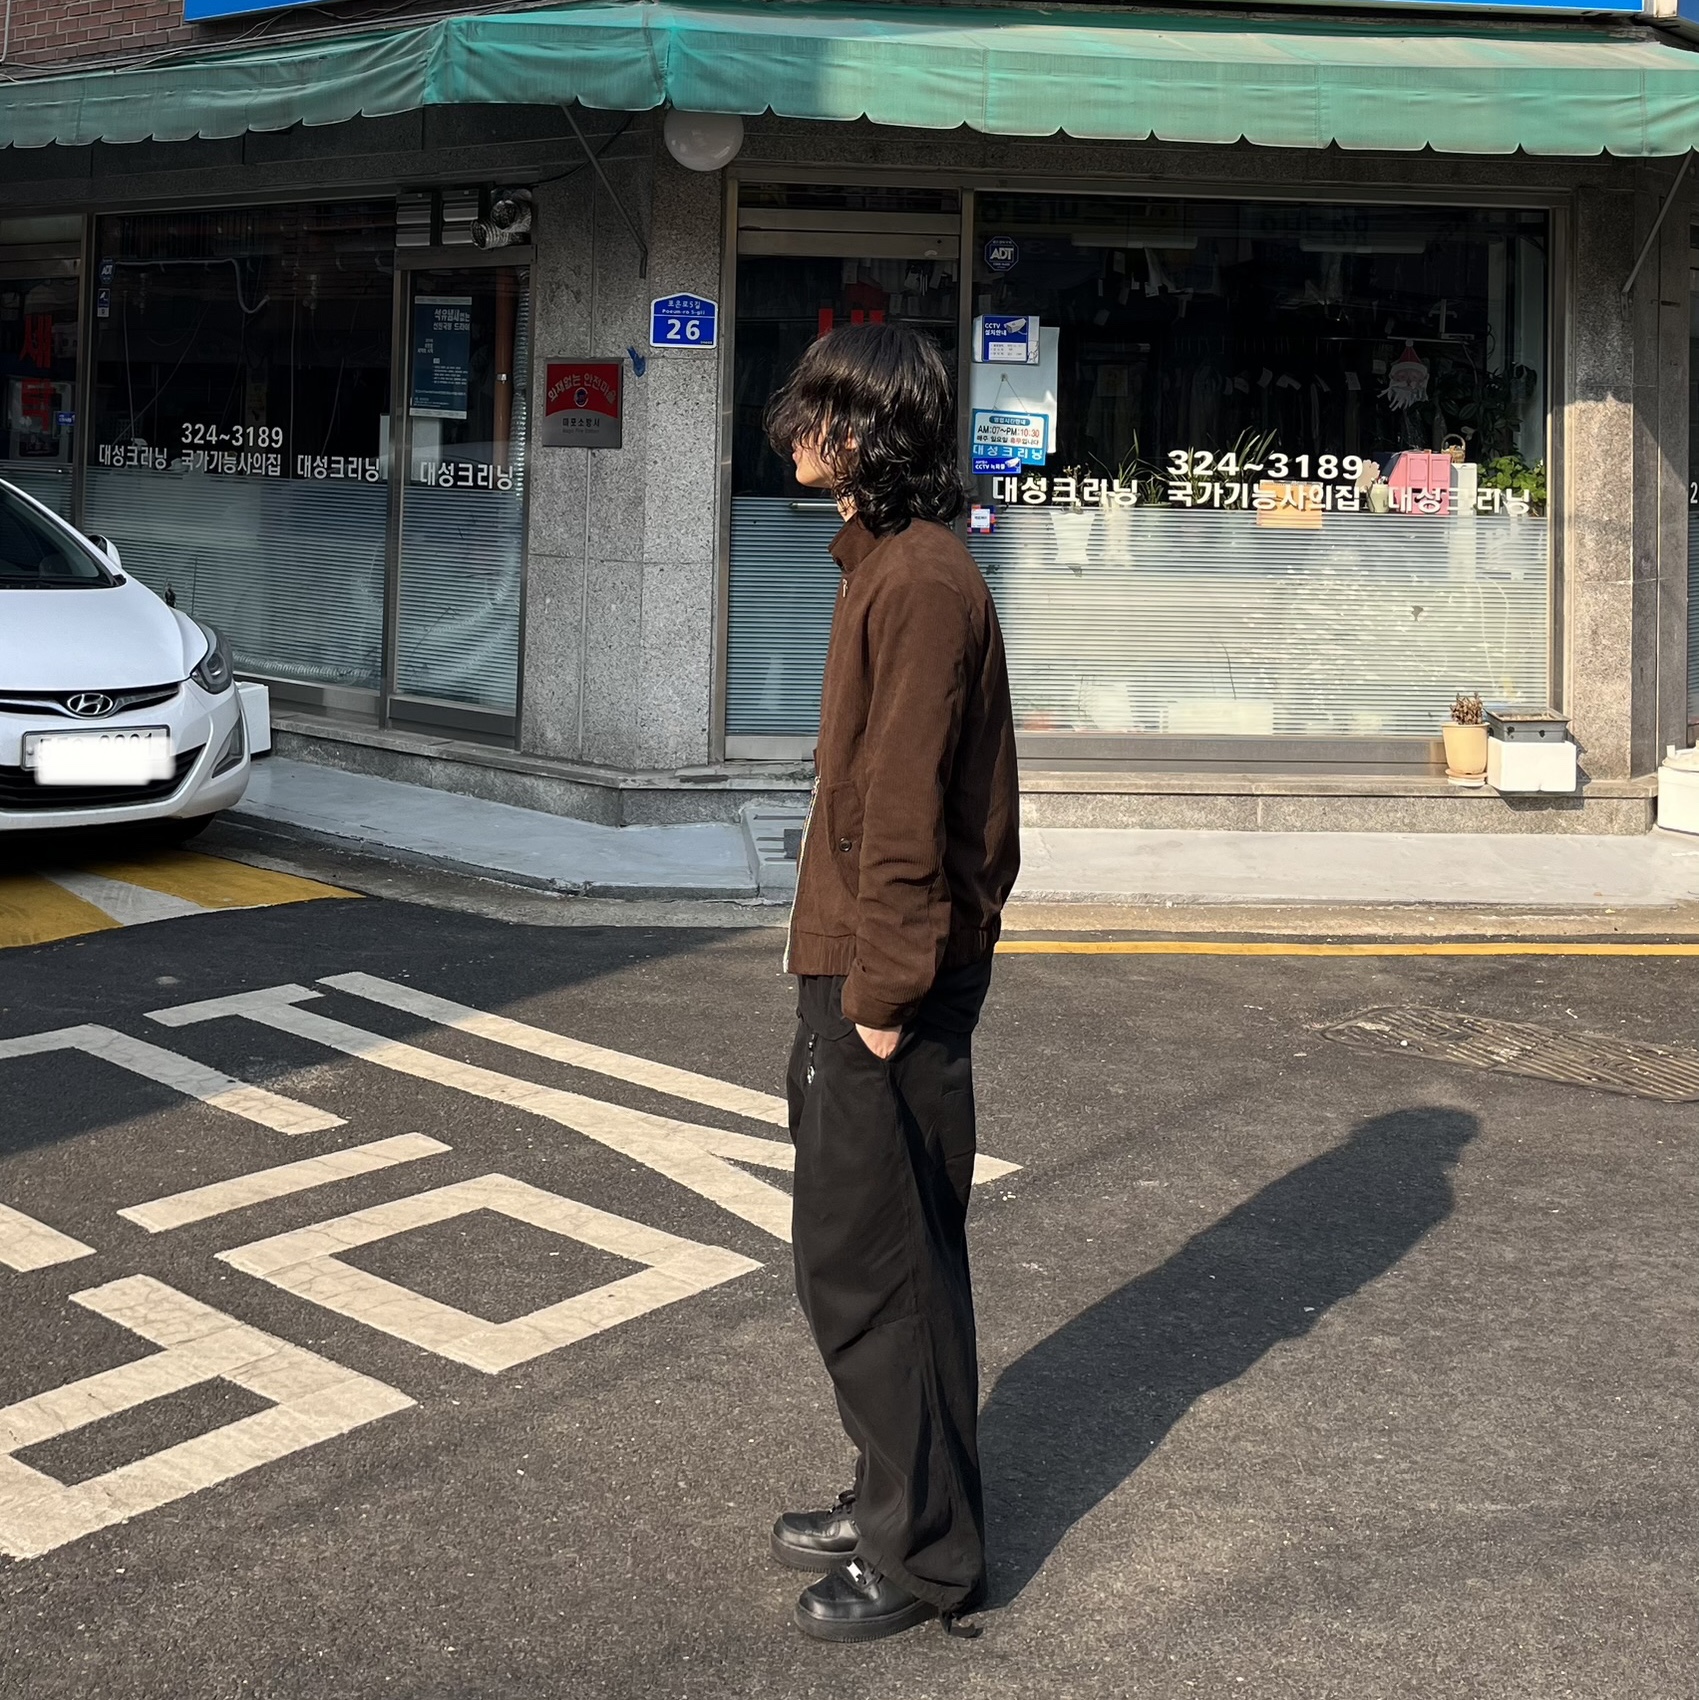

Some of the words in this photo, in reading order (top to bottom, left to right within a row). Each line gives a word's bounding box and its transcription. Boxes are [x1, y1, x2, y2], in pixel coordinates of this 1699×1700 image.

[989, 247, 1014, 260] ADT
[666, 318, 700, 341] 26
[993, 417, 1026, 425] 영업시간안내
[181, 423, 283, 449] 324~3189
[990, 435, 1008, 443] 일요일
[99, 444, 168, 469] 대성크리닝
[180, 449, 282, 476] 국가기능사의집
[972, 444, 1043, 461] 대성크리닝
[1166, 448, 1363, 480] 324~3189
[297, 454, 380, 482] 대성크리닝
[419, 461, 514, 490] 대성크리닝
[992, 476, 1139, 508] 대성크리닝
[1166, 481, 1361, 513] 국가기능사의집
[1388, 486, 1531, 515] 대성크리닝
